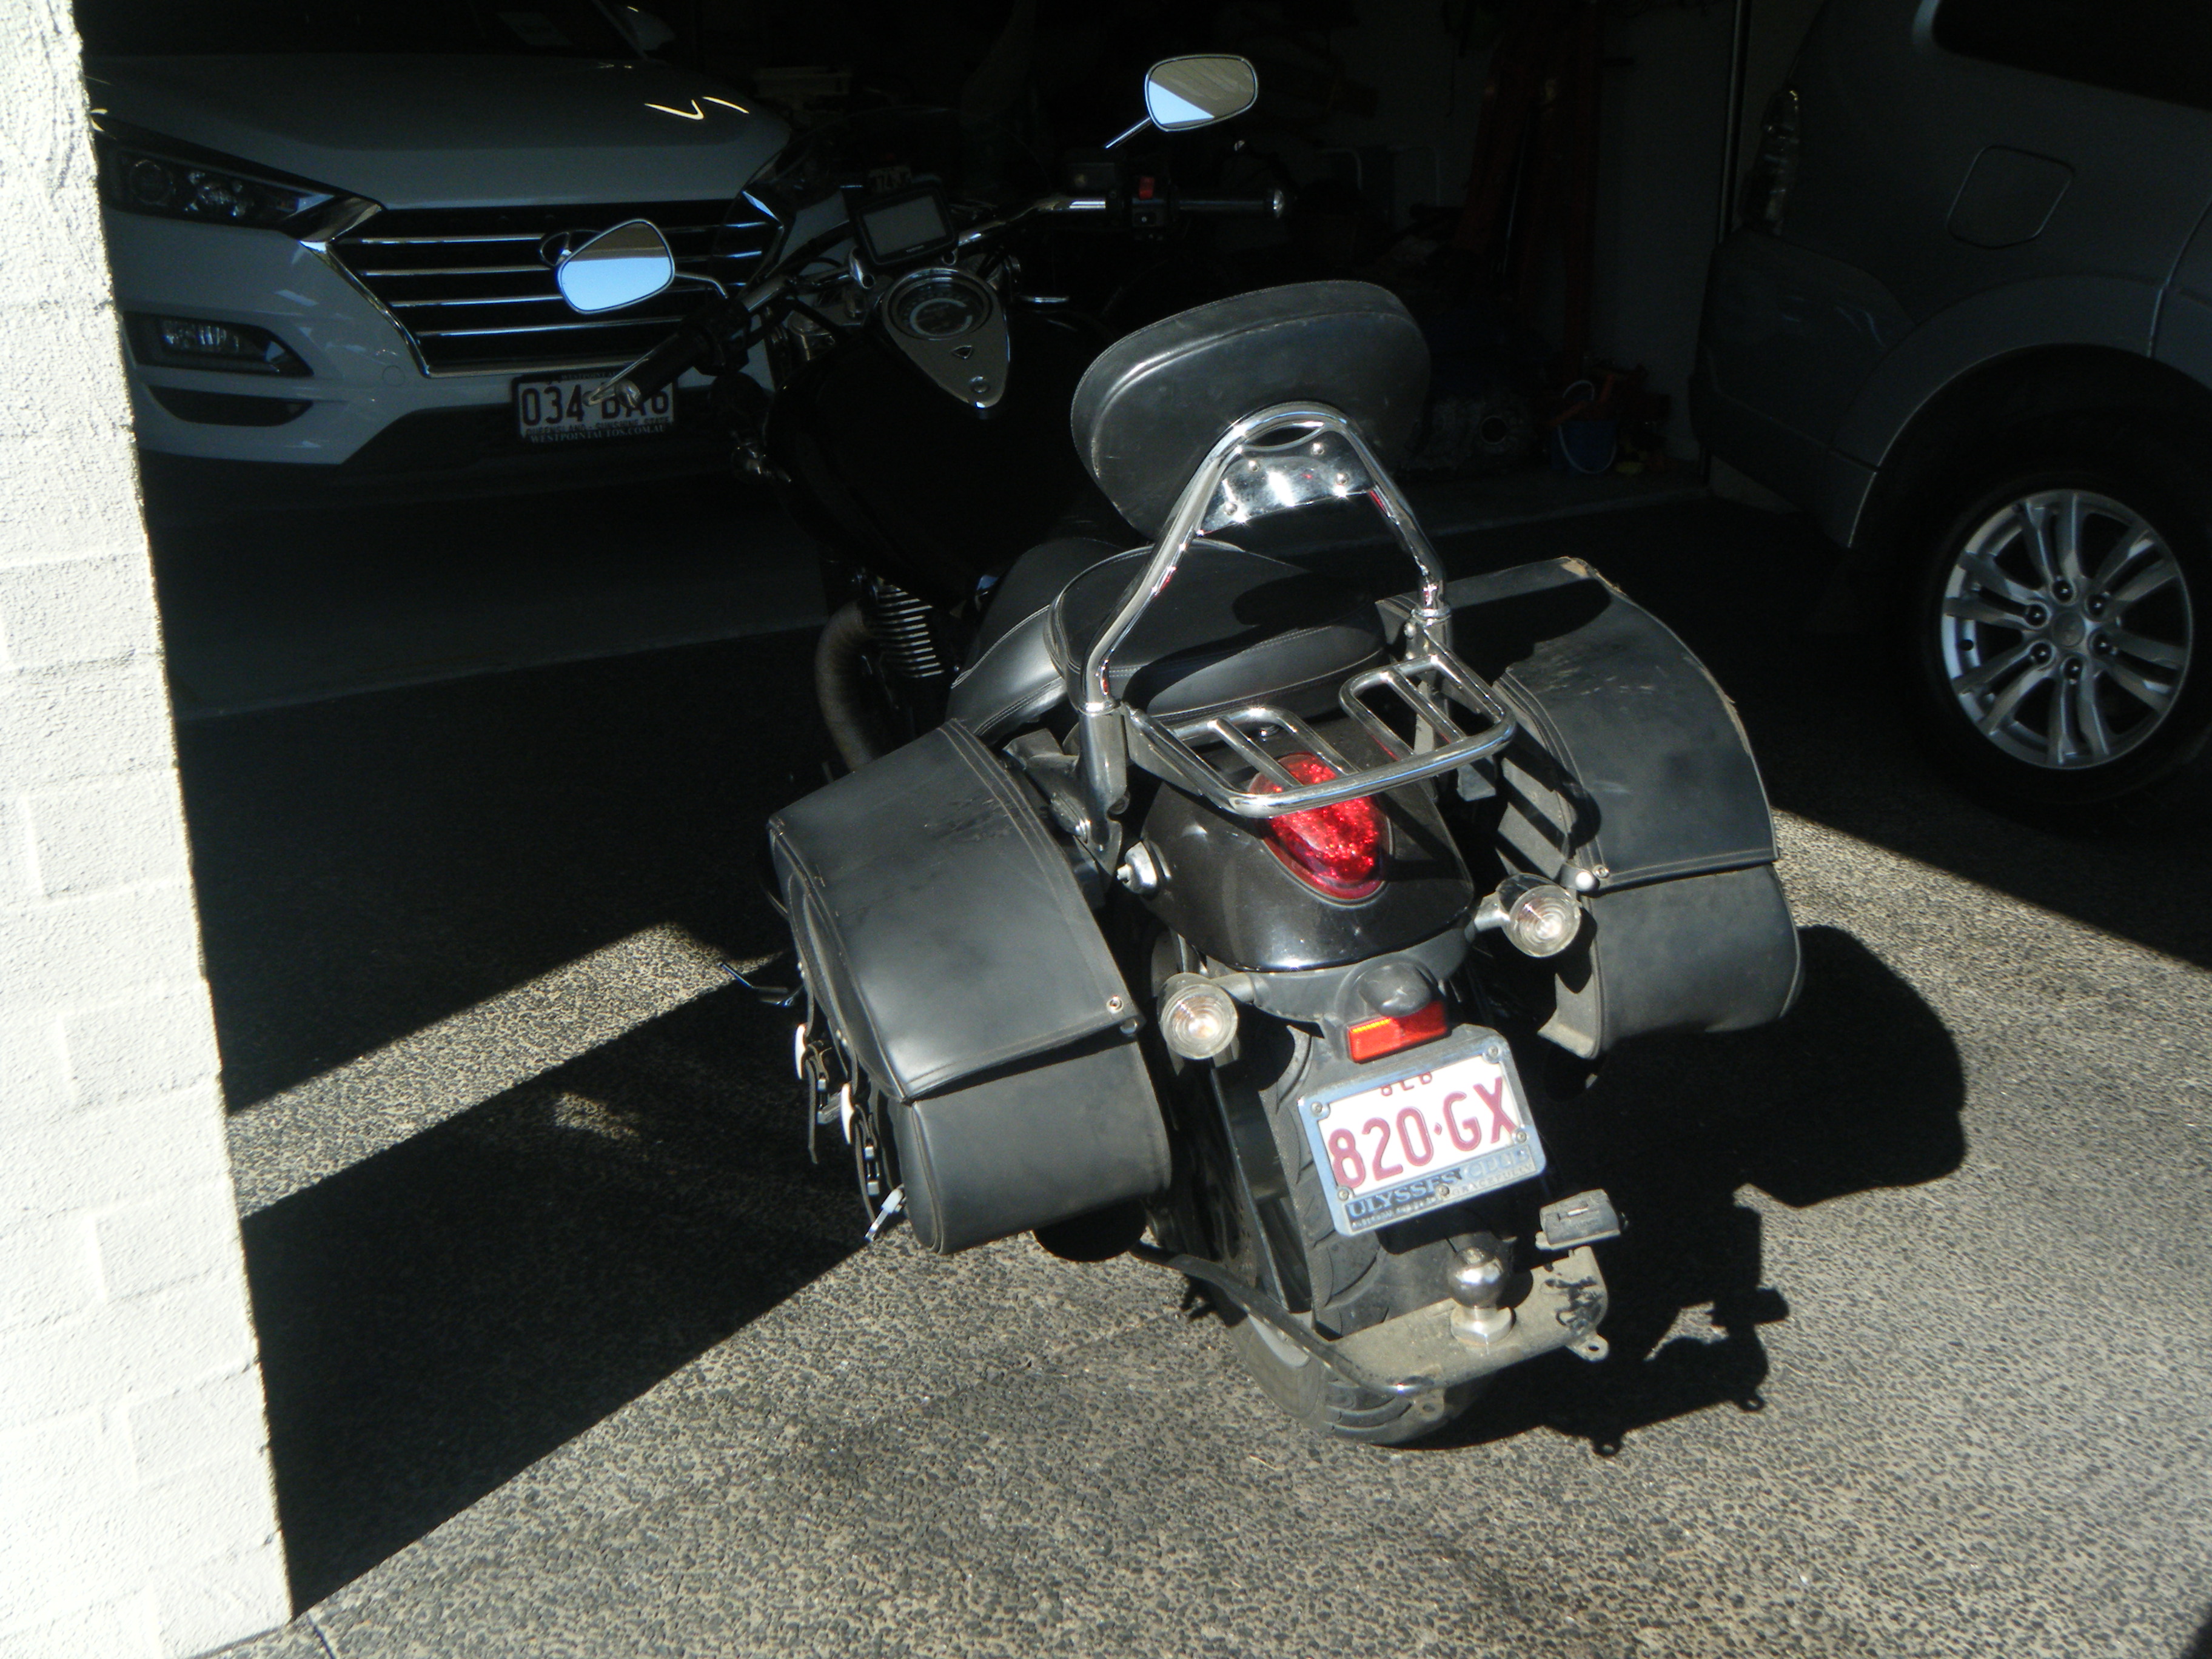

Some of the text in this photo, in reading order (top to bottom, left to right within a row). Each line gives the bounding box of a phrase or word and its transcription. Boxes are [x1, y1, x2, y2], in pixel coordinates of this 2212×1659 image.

[521, 384, 585, 426] 034
[1347, 1169, 1461, 1217] ULYSSES
[1464, 1150, 1529, 1179] CLUB
